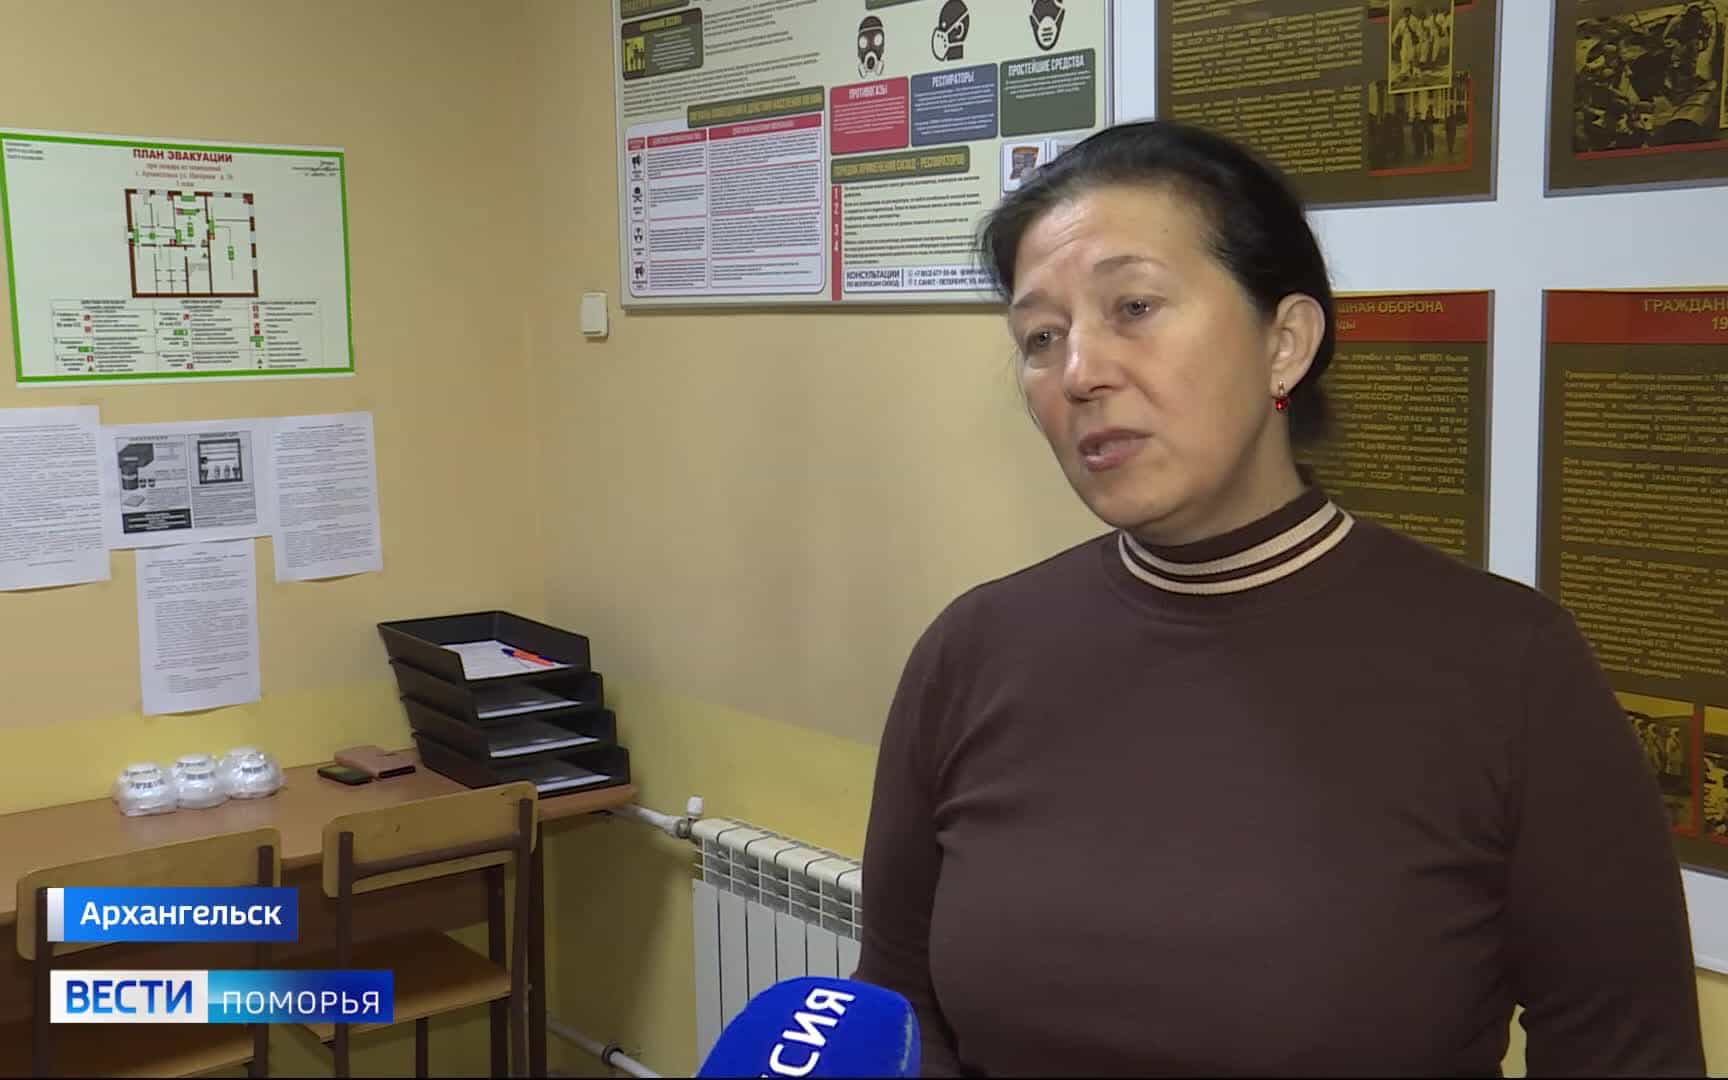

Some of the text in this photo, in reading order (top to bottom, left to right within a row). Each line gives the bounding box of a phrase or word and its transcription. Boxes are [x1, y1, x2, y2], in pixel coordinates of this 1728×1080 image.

[1008, 54, 1086, 77] ПРОСТЕЙШИЕ СРЕДСТВА
[932, 71, 975, 88] РЕСПИРАТОРЫ
[848, 84, 889, 99] ПРОТИВОГАЗЫ
[132, 148, 233, 163] ПЛАН ЭВАКУАЦИИ
[846, 270, 900, 280] КОНСУЛЬТАЦИИ
[1337, 300, 1444, 313] ШНАЯ ОБОРОНА
[1643, 298, 1728, 313] ГРАЖДАН
[1712, 316, 1728, 330] 19
[761, 988, 856, 1077] СИЯ
